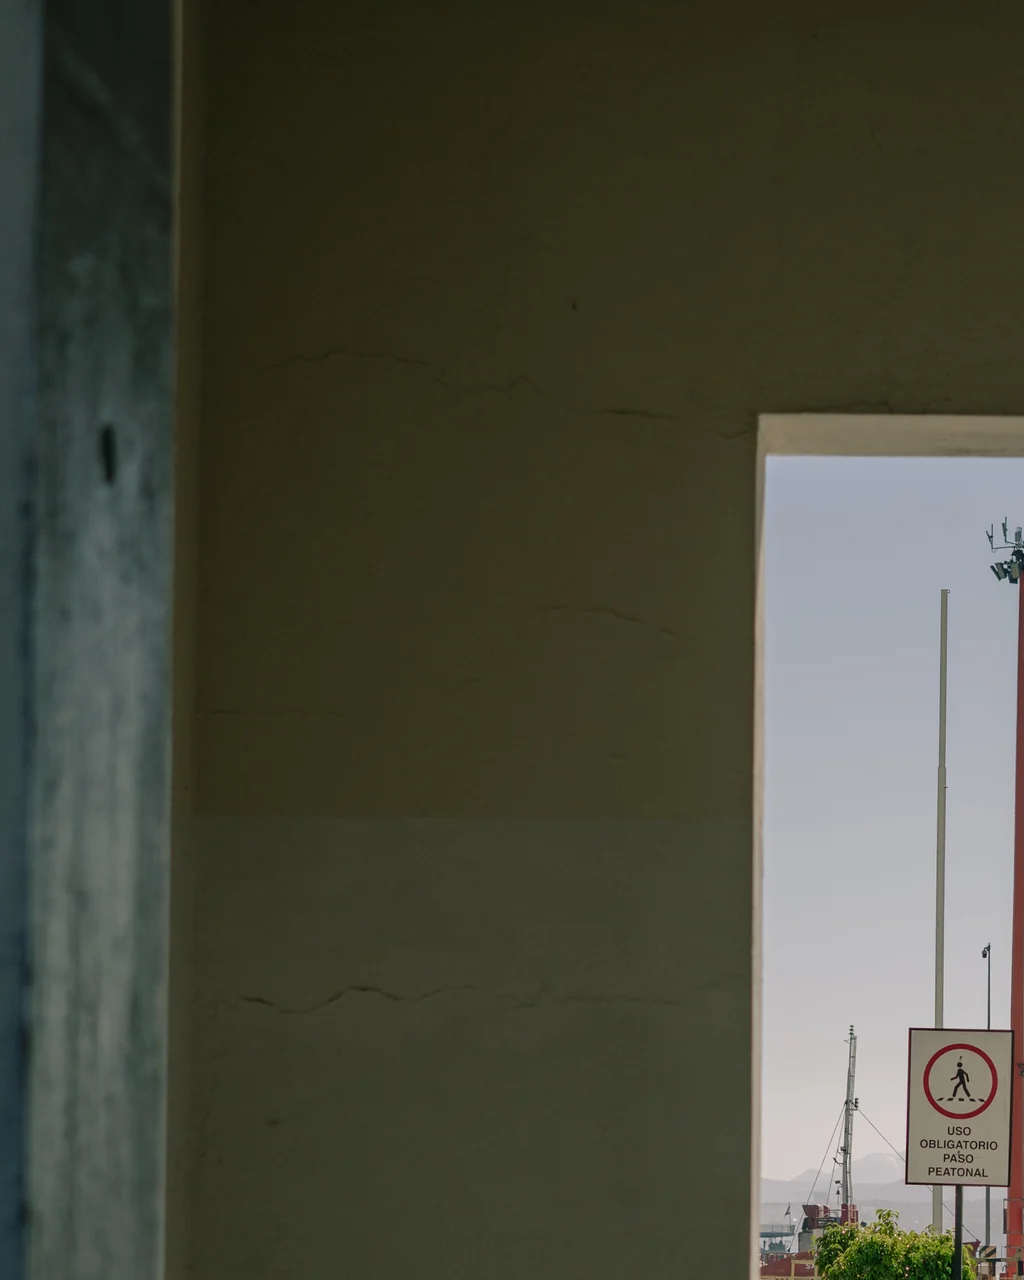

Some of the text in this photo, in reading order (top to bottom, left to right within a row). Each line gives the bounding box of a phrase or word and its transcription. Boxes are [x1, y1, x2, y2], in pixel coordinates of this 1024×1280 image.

[947, 1126, 971, 1136] USO
[920, 1139, 998, 1150] OBLIGATORIO
[943, 1154, 974, 1163] PASO
[928, 1167, 988, 1177] PEATONAL
